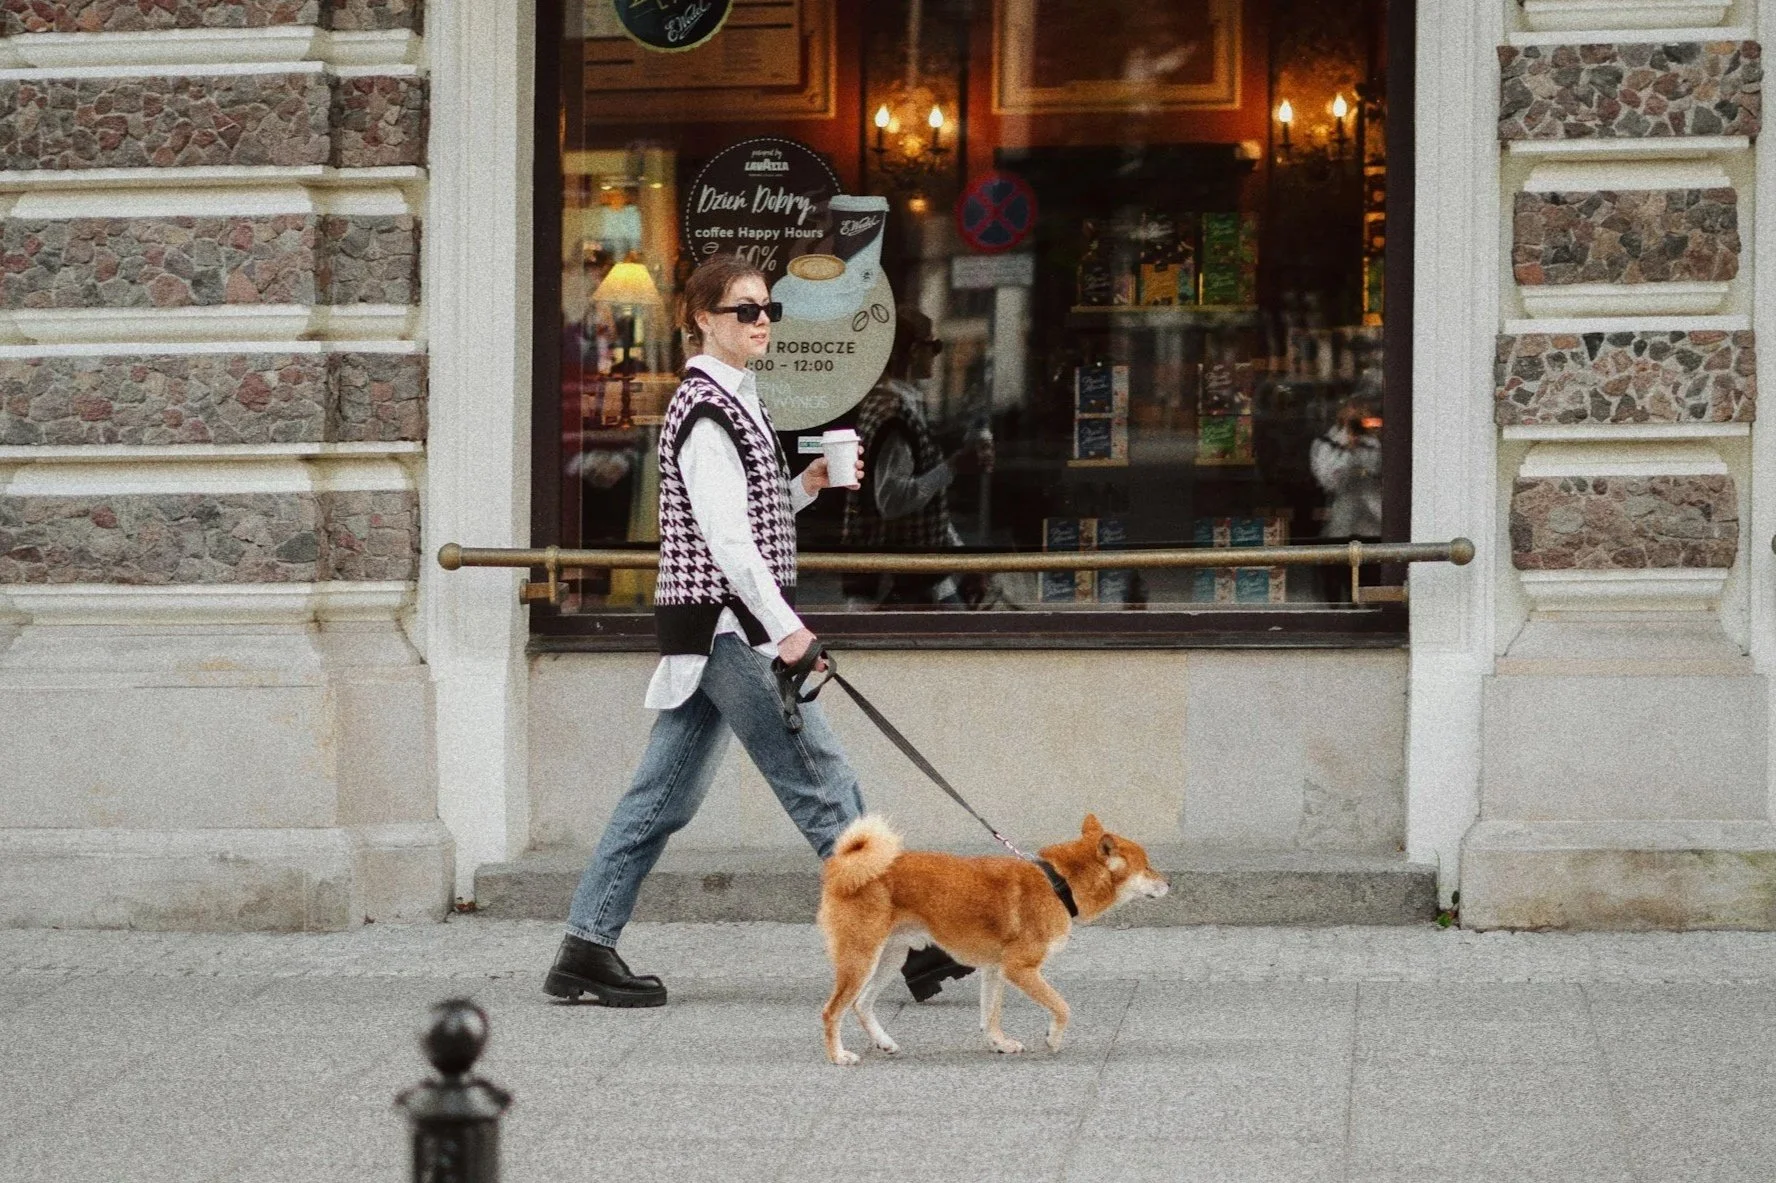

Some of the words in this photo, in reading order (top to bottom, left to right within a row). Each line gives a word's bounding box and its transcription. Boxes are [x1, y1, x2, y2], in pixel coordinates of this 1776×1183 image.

[744, 158, 789, 172] LAVAZZA
[697, 184, 749, 213] Dzień
[695, 227, 734, 239] coffee
[738, 227, 780, 241] Happy
[784, 227, 824, 239] Hours
[776, 341, 856, 354] ROBOCZE
[793, 360, 834, 371] 12:00
